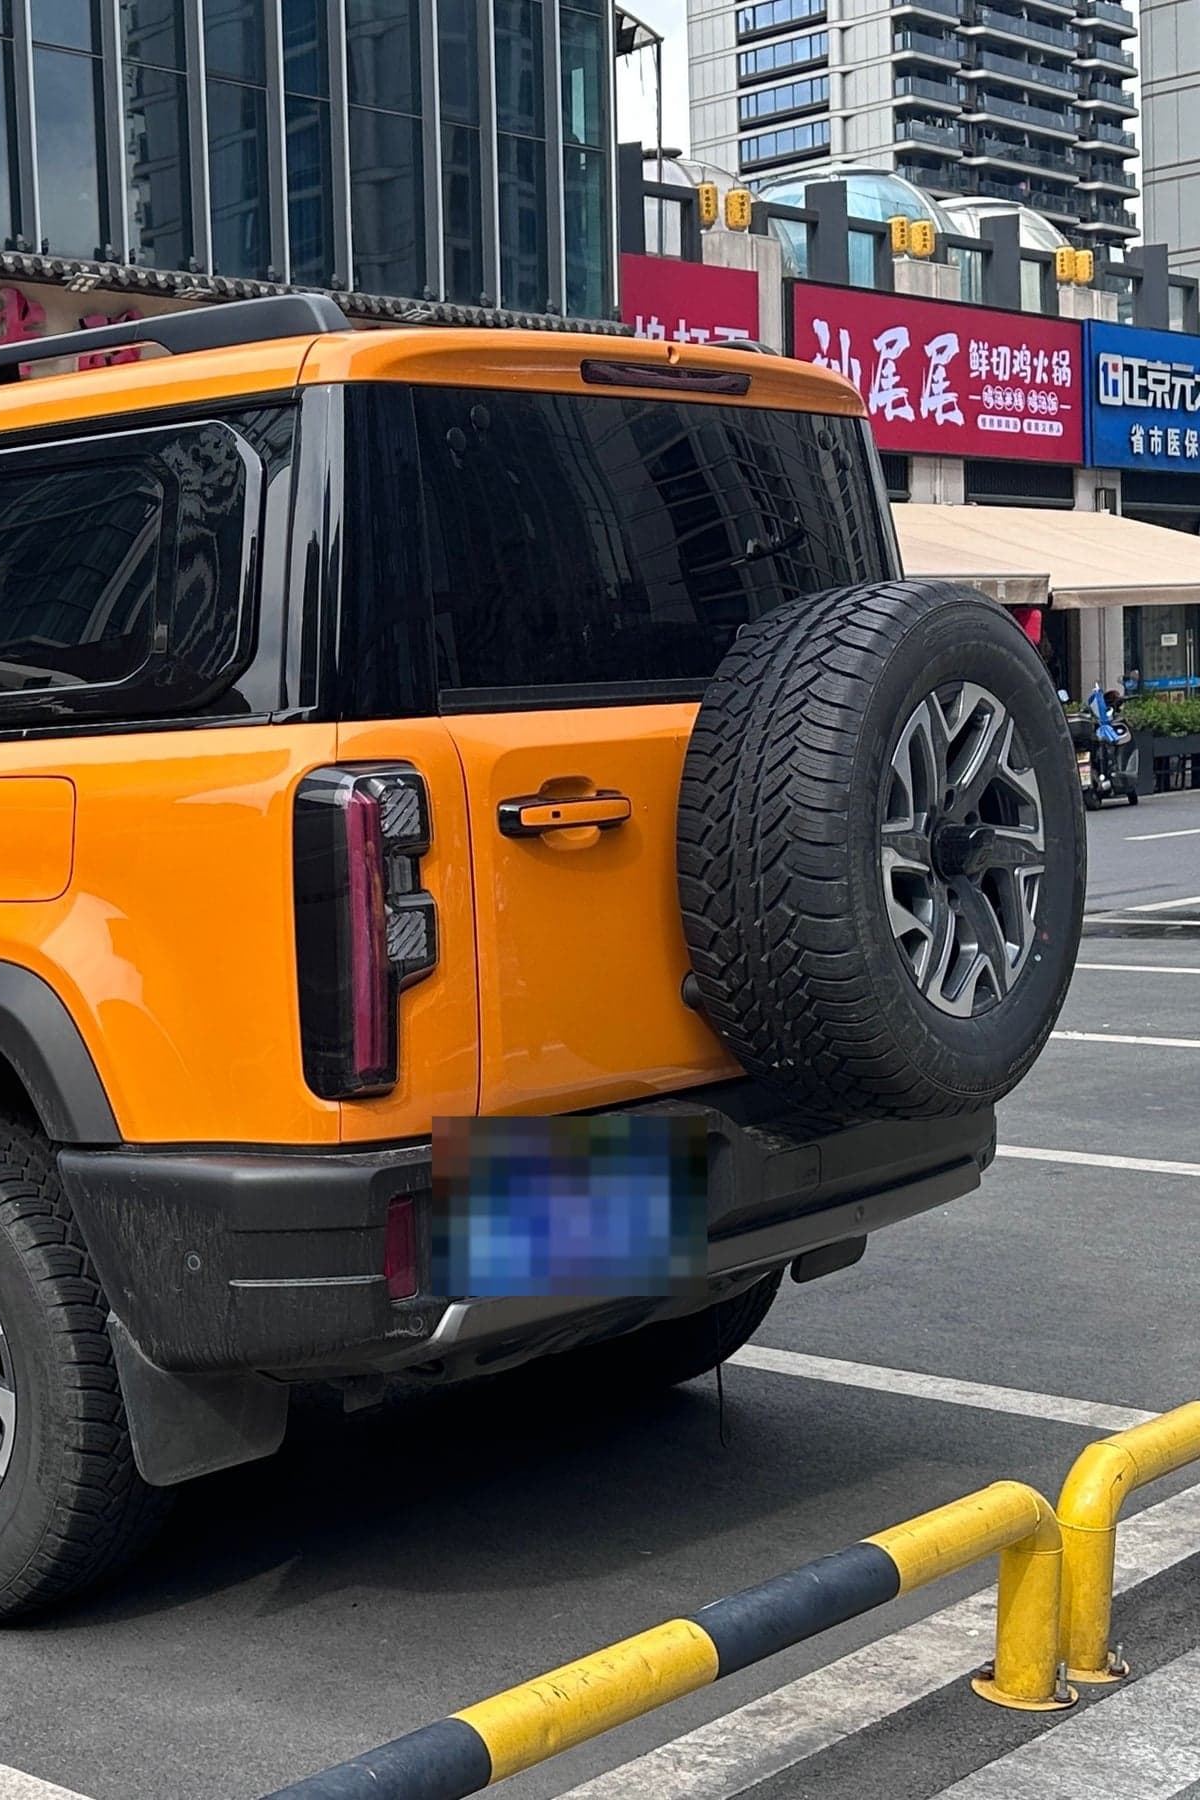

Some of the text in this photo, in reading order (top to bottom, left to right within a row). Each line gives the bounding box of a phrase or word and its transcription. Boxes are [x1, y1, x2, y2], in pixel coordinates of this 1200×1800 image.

[969, 338, 1072, 388] 鲜切鸡火锅
[1123, 356, 1200, 412] 正京元
[1131, 422, 1199, 458] 省市医保
